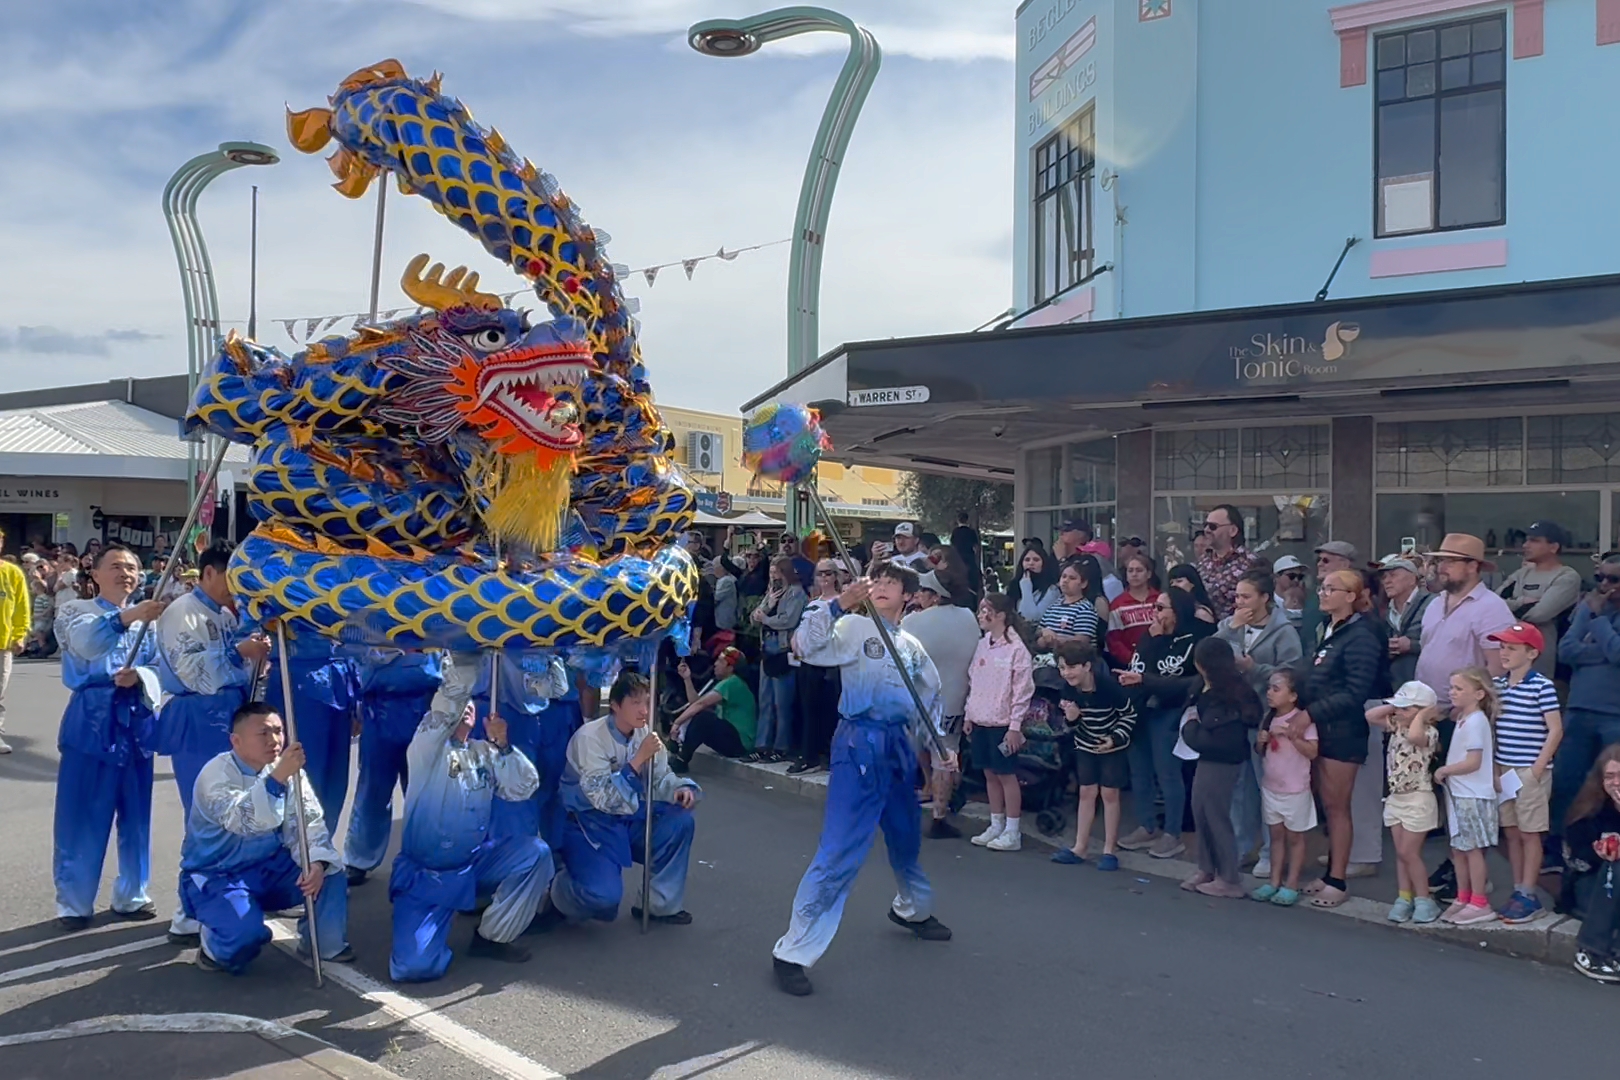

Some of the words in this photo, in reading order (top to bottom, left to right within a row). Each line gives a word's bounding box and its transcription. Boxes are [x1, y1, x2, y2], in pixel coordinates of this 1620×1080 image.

[1028, 60, 1097, 137] BUILDINGS
[1229, 346, 1249, 357] The
[1249, 333, 1305, 357] Skin
[1306, 342, 1317, 353] &
[1230, 355, 1301, 379] Tonic
[1303, 365, 1338, 375] Room
[858, 390, 900, 403] WARREN
[905, 389, 917, 401] ST
[16, 489, 59, 498] WINES
